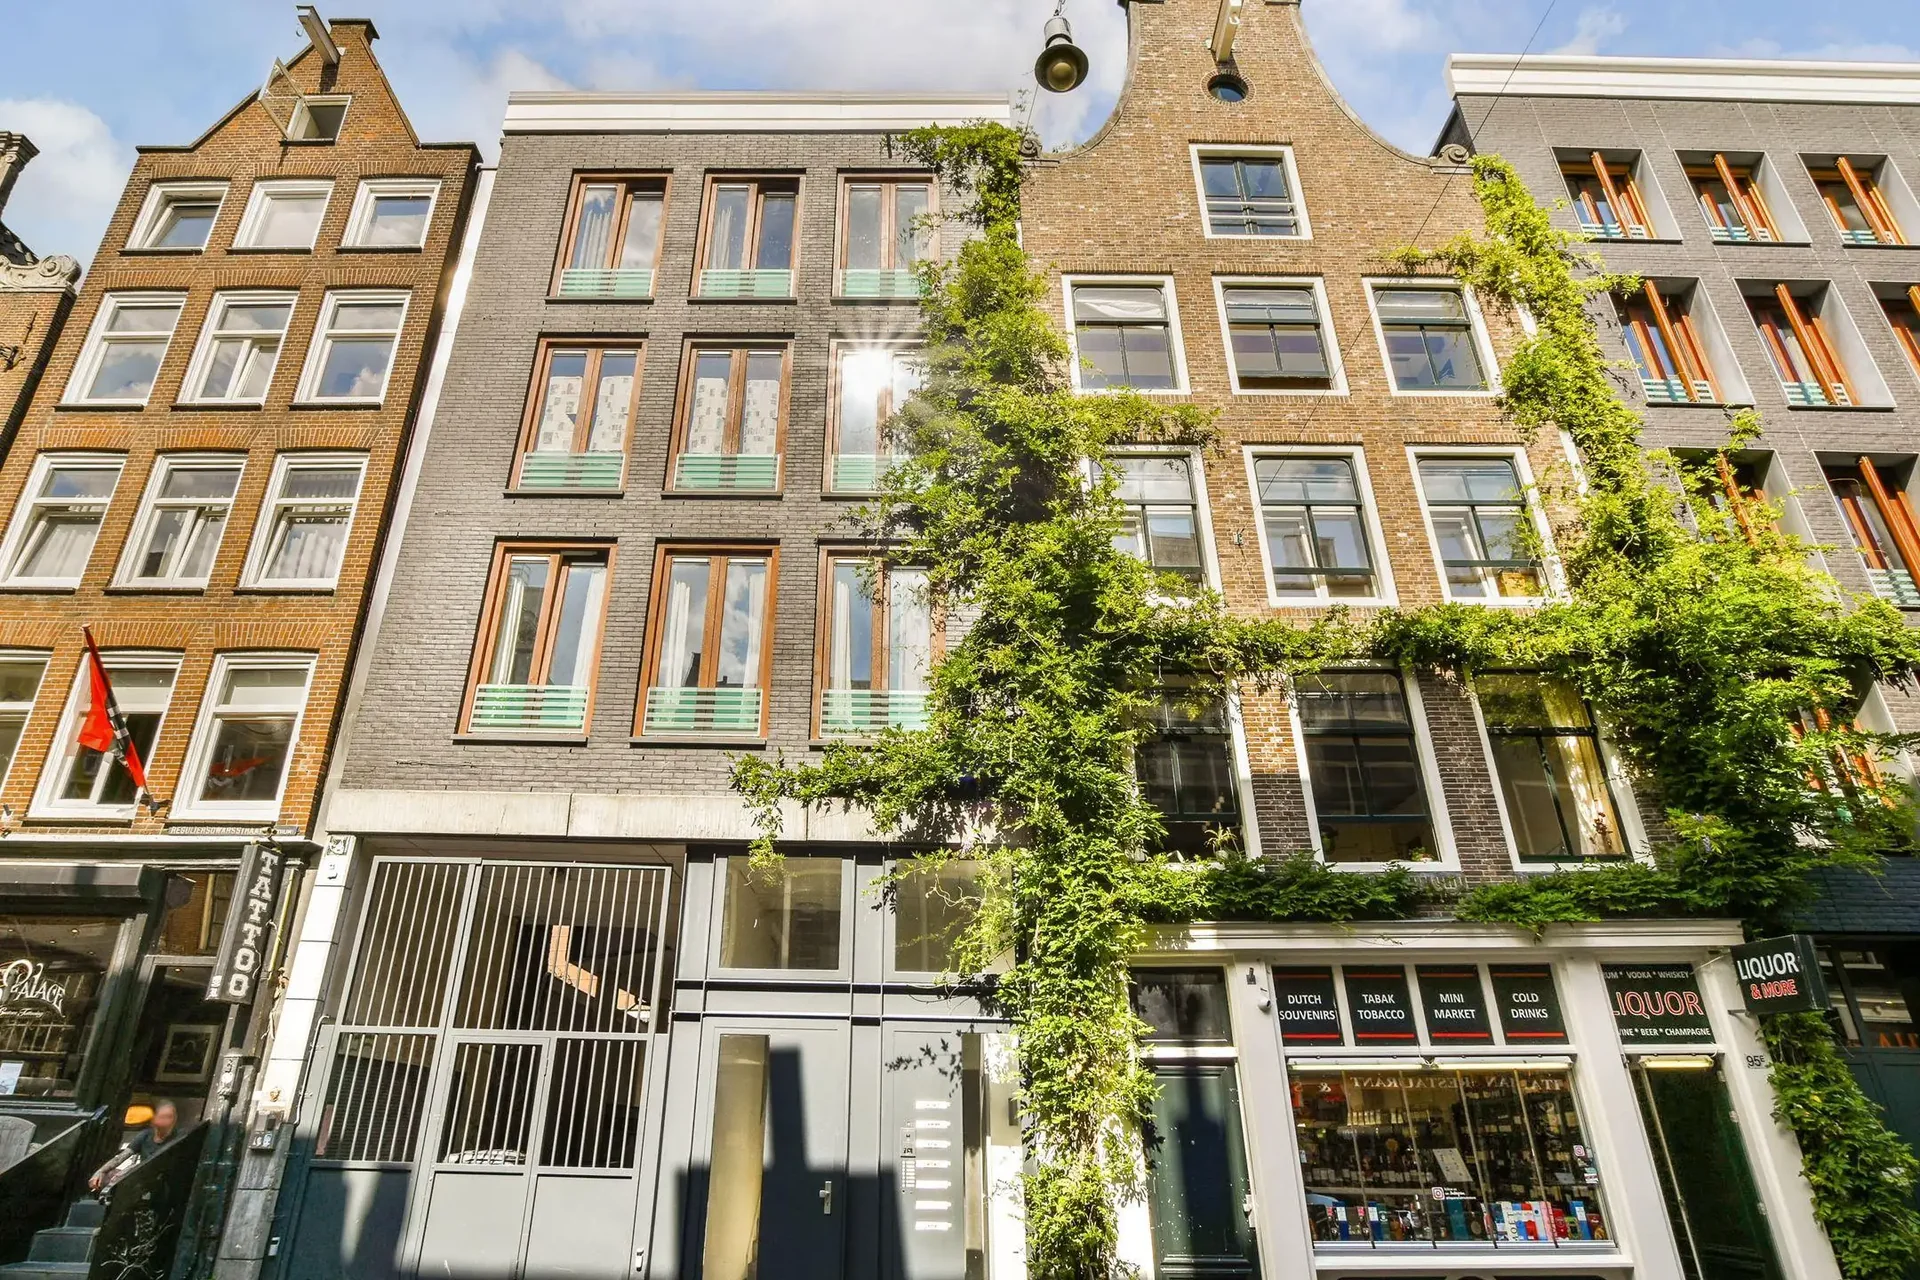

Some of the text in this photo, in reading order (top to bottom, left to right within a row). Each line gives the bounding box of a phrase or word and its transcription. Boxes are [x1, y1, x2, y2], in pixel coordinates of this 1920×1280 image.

[228, 850, 279, 998] TATTOO
[1737, 952, 1799, 980] LIQUOR
[1626, 971, 1652, 979] VODKA
[1657, 970, 1689, 979] WHISKEY
[1750, 979, 1798, 999] & MORE
[1287, 994, 1322, 1005] DUTCH
[1362, 994, 1396, 1004] TABAK
[1439, 993, 1464, 1003] MINI
[1512, 993, 1539, 1003] COLD
[1280, 1009, 1336, 1020] SOUVENIRS
[1357, 1009, 1405, 1020] TOBACCO
[1434, 1009, 1476, 1019] MARKET
[1510, 1008, 1548, 1019] DRINKS
[1640, 1028, 1659, 1036] BEER
[1665, 1027, 1711, 1036] CHAMPAGNE
